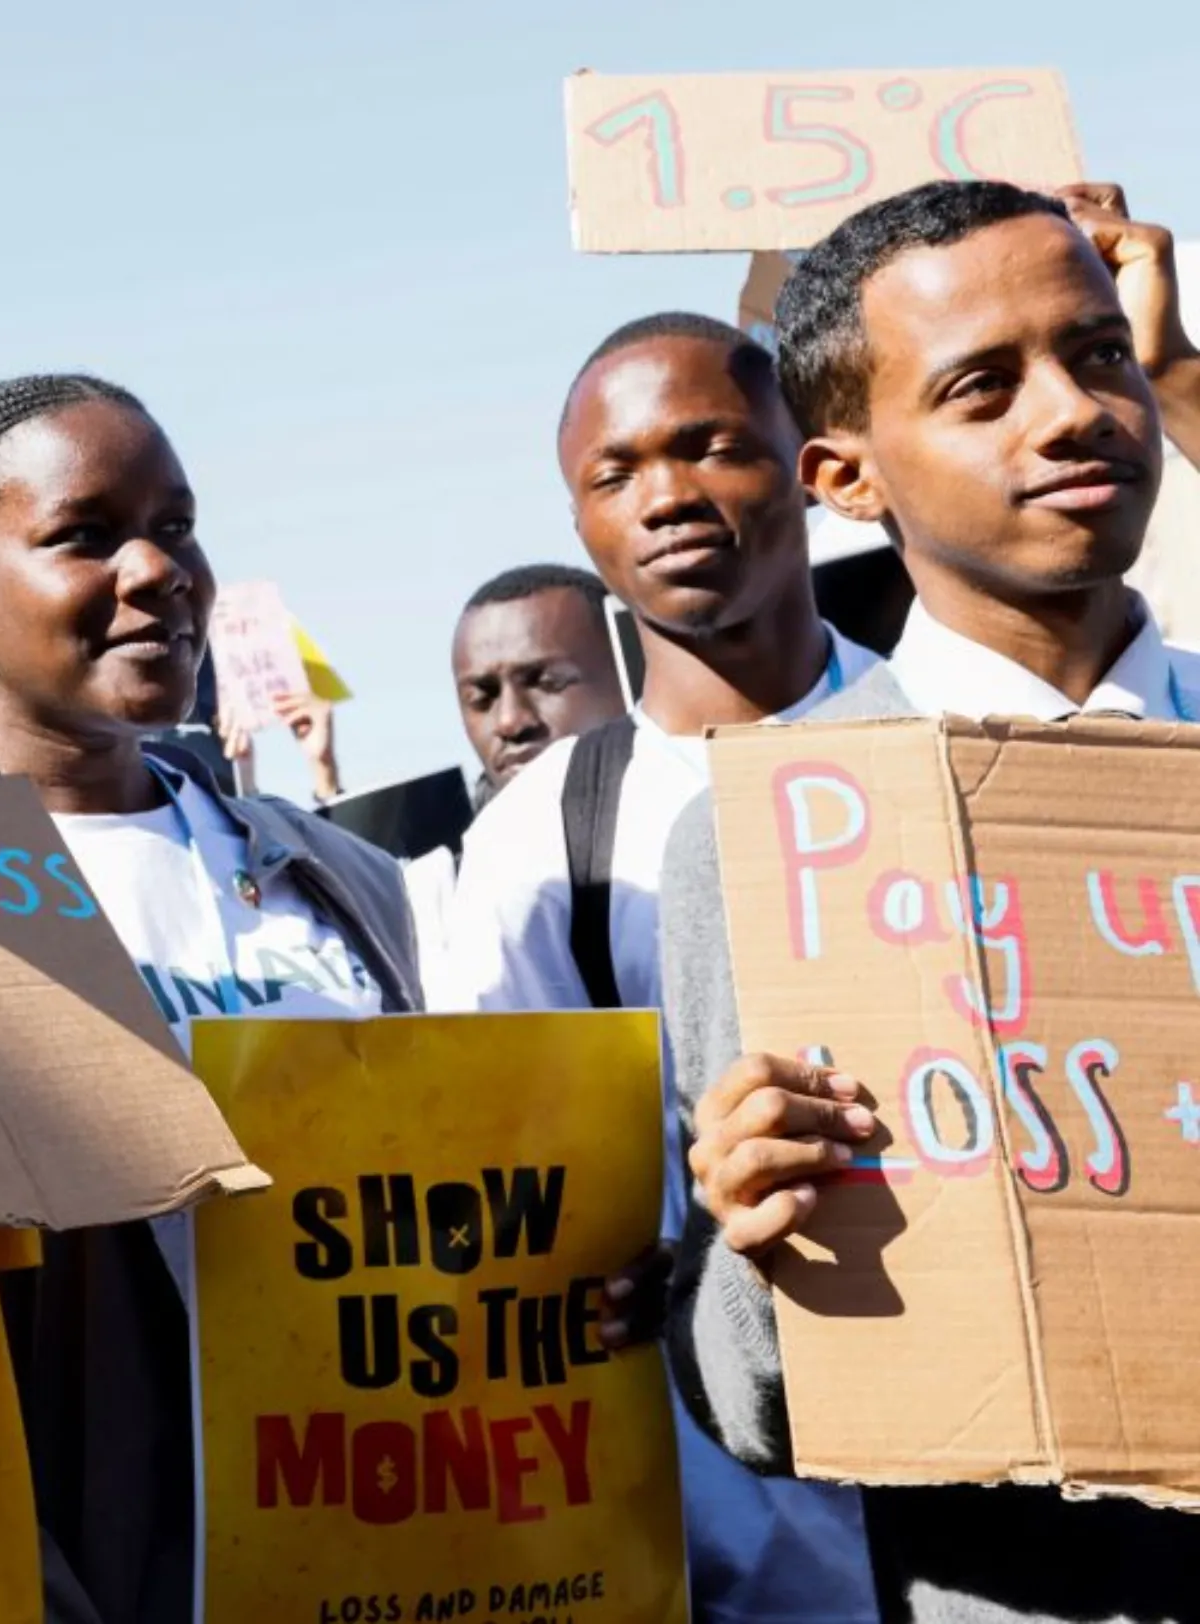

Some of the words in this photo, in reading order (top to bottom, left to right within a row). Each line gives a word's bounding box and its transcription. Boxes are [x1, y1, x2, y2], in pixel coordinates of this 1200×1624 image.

[771, 759, 1034, 1038] Pay
[291, 1165, 567, 1282] SHOW
[337, 1293, 461, 1398] US
[477, 1276, 611, 1389] THE
[254, 1400, 594, 1526] MONEY
[319, 1594, 403, 1624] LOSS
[414, 1588, 477, 1622] AND
[488, 1571, 606, 1614] DAMAGE
